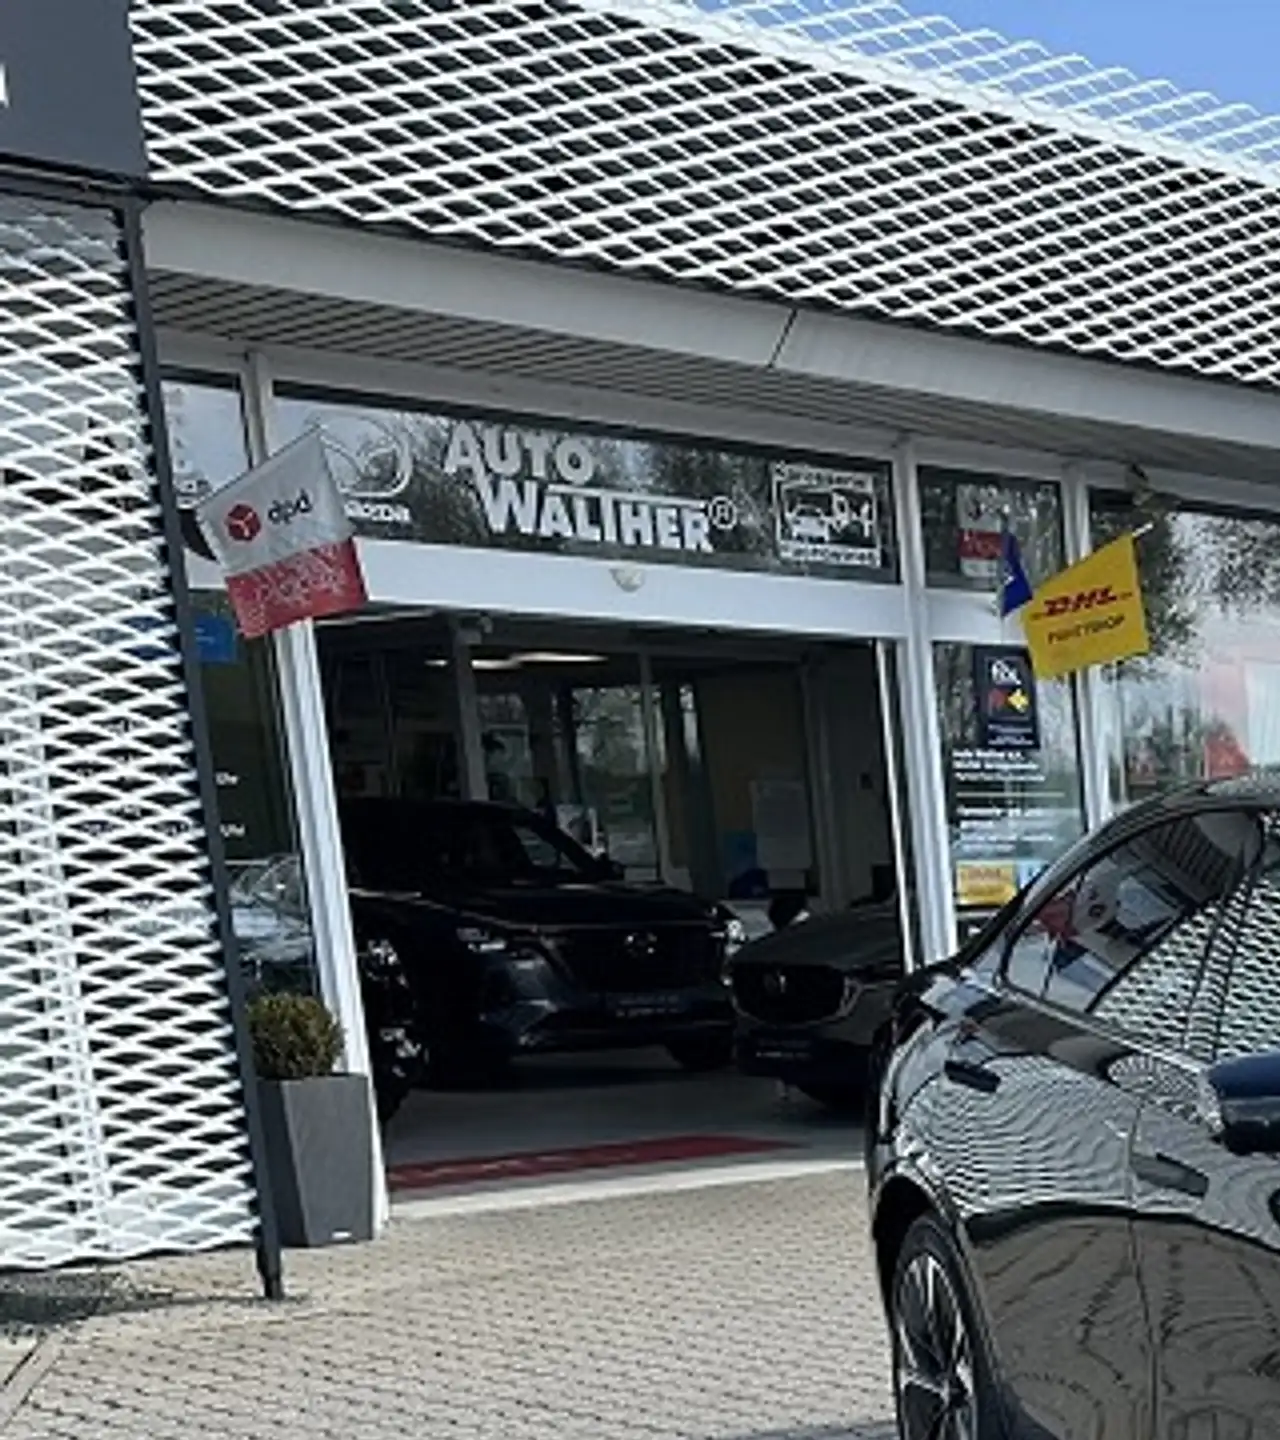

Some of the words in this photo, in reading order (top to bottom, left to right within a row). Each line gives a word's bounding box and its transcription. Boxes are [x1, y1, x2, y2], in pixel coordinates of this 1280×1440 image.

[444, 420, 596, 485] AUTO
[268, 487, 313, 525] dpd
[477, 479, 715, 553] WALTHER
[1043, 584, 1118, 617] DHL
